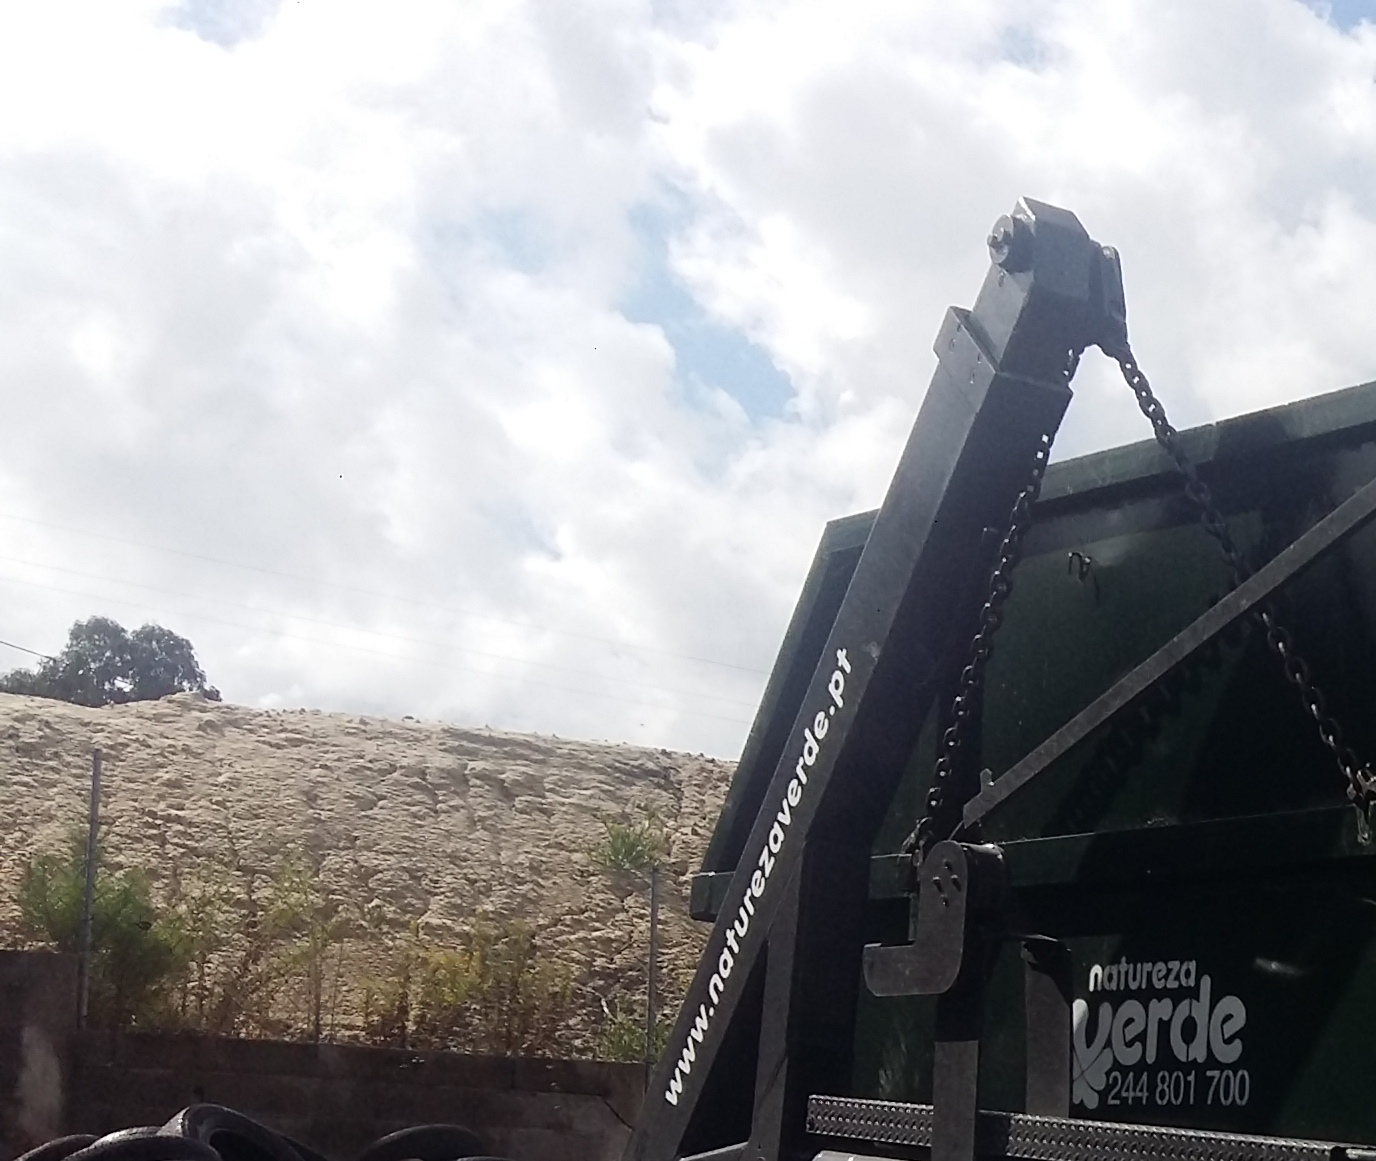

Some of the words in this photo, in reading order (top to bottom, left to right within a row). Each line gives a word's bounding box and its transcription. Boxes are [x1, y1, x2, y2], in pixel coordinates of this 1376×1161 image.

[664, 647, 852, 1107] www.naturezaverde.pt
[1089, 956, 1197, 992] natureza
[1073, 974, 1247, 1066] verde
[1107, 1070, 1149, 1106] 244
[1155, 1069, 1196, 1106] 801
[1205, 1069, 1250, 1106] 700
